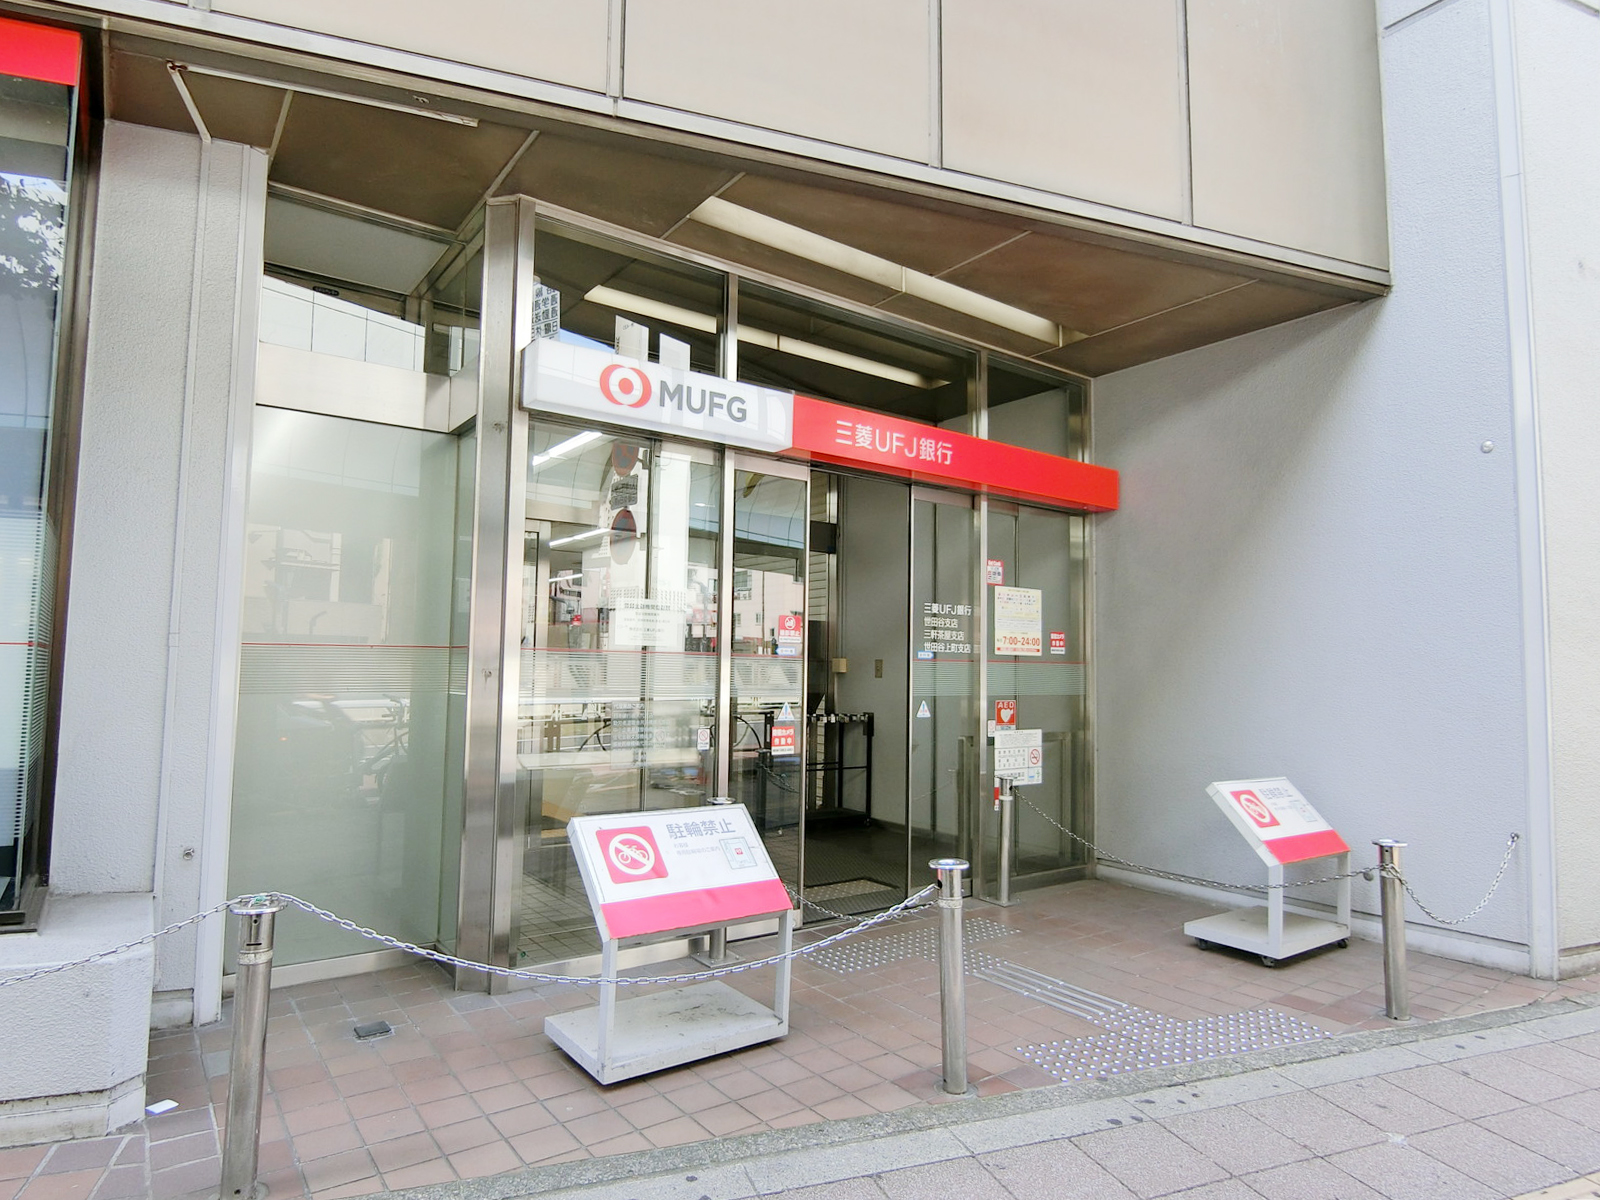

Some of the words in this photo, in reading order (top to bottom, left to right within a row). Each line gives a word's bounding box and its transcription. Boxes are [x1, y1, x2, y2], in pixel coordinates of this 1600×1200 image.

[660, 380, 748, 423] MUFG
[835, 420, 953, 465] 三菱UFJ銀行
[923, 602, 972, 616] 三菱UFJ銀行
[923, 617, 959, 629] 世田谷支店
[923, 629, 965, 641] 三軒茶屋支店
[923, 641, 972, 654] 世田谷上町支店
[997, 701, 1015, 709] AED
[666, 817, 737, 840] 駐輪禁止
